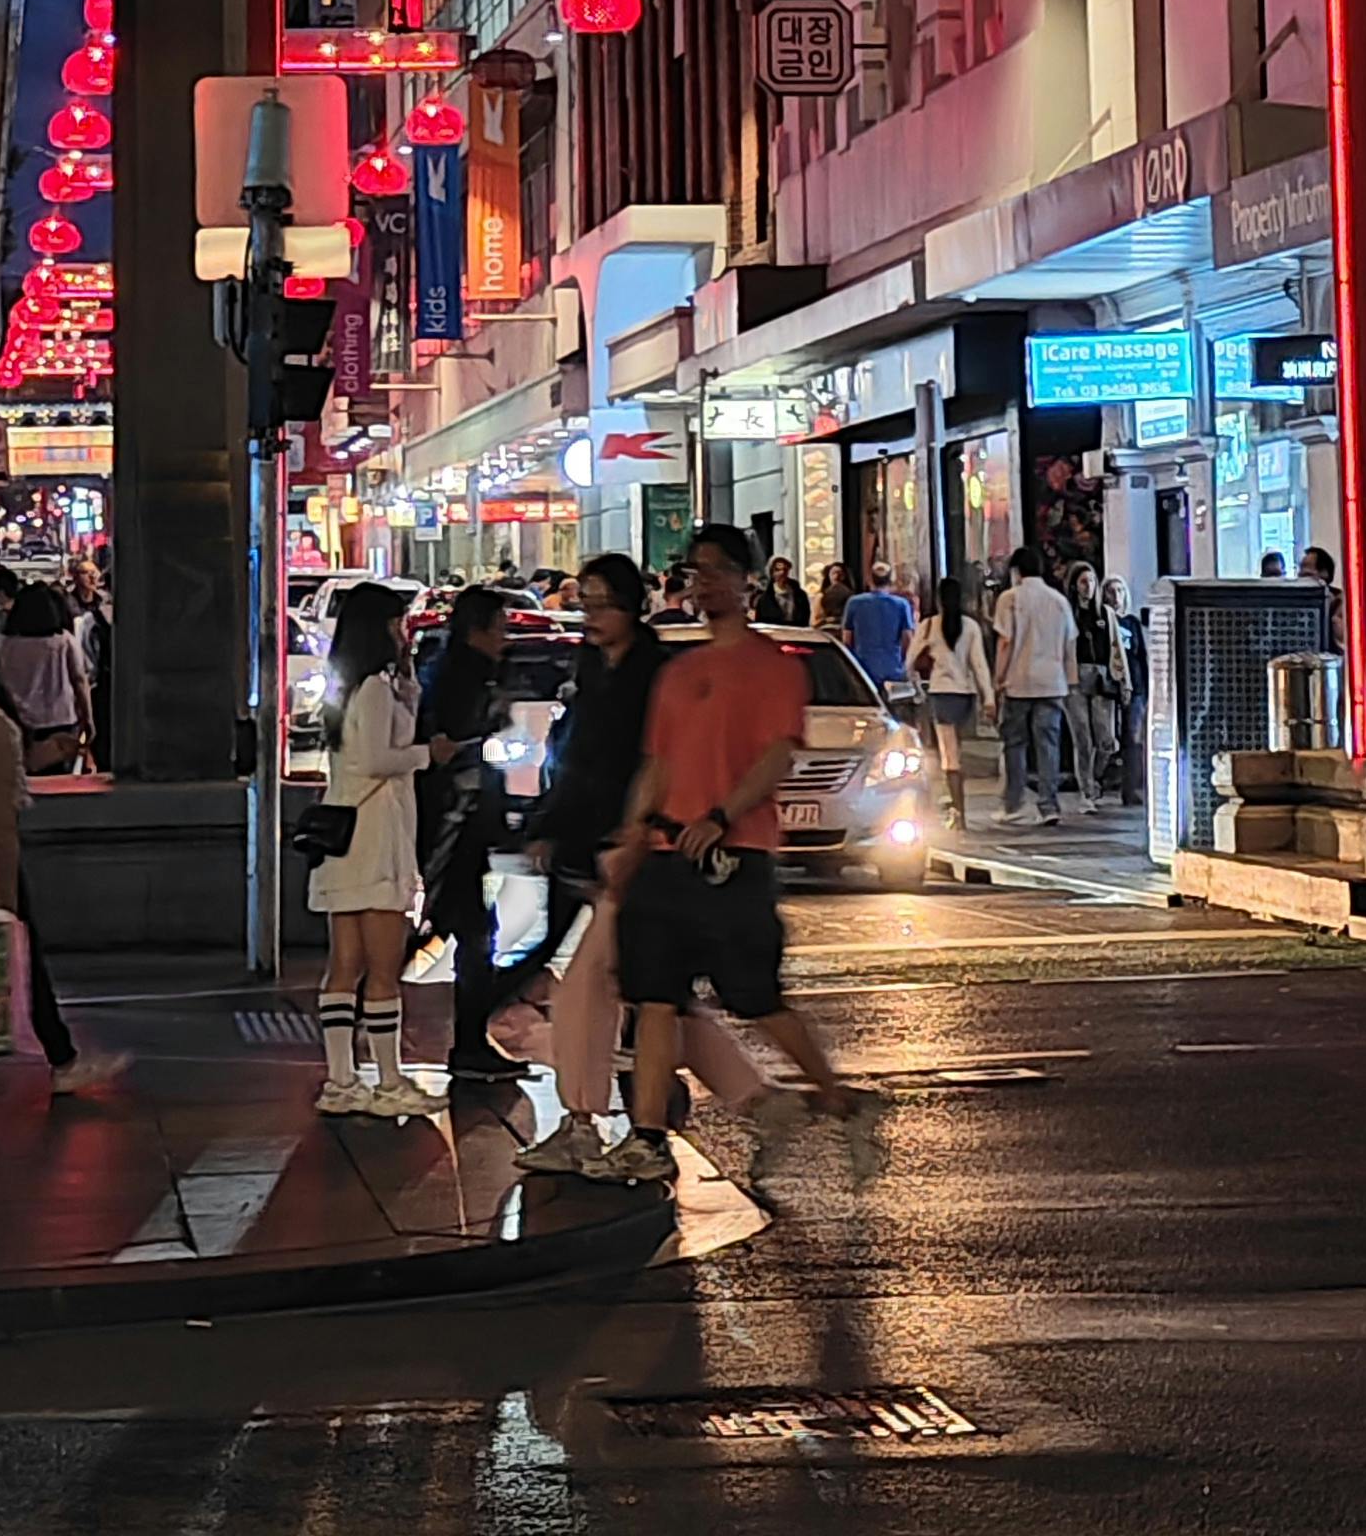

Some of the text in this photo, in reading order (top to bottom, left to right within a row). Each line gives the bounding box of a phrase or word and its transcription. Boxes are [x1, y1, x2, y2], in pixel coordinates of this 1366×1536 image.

[1232, 193, 1285, 253] Property
[480, 215, 504, 292] home
[424, 285, 447, 334] kids
[339, 313, 364, 393] clothing
[1094, 342, 1180, 361] Massage
